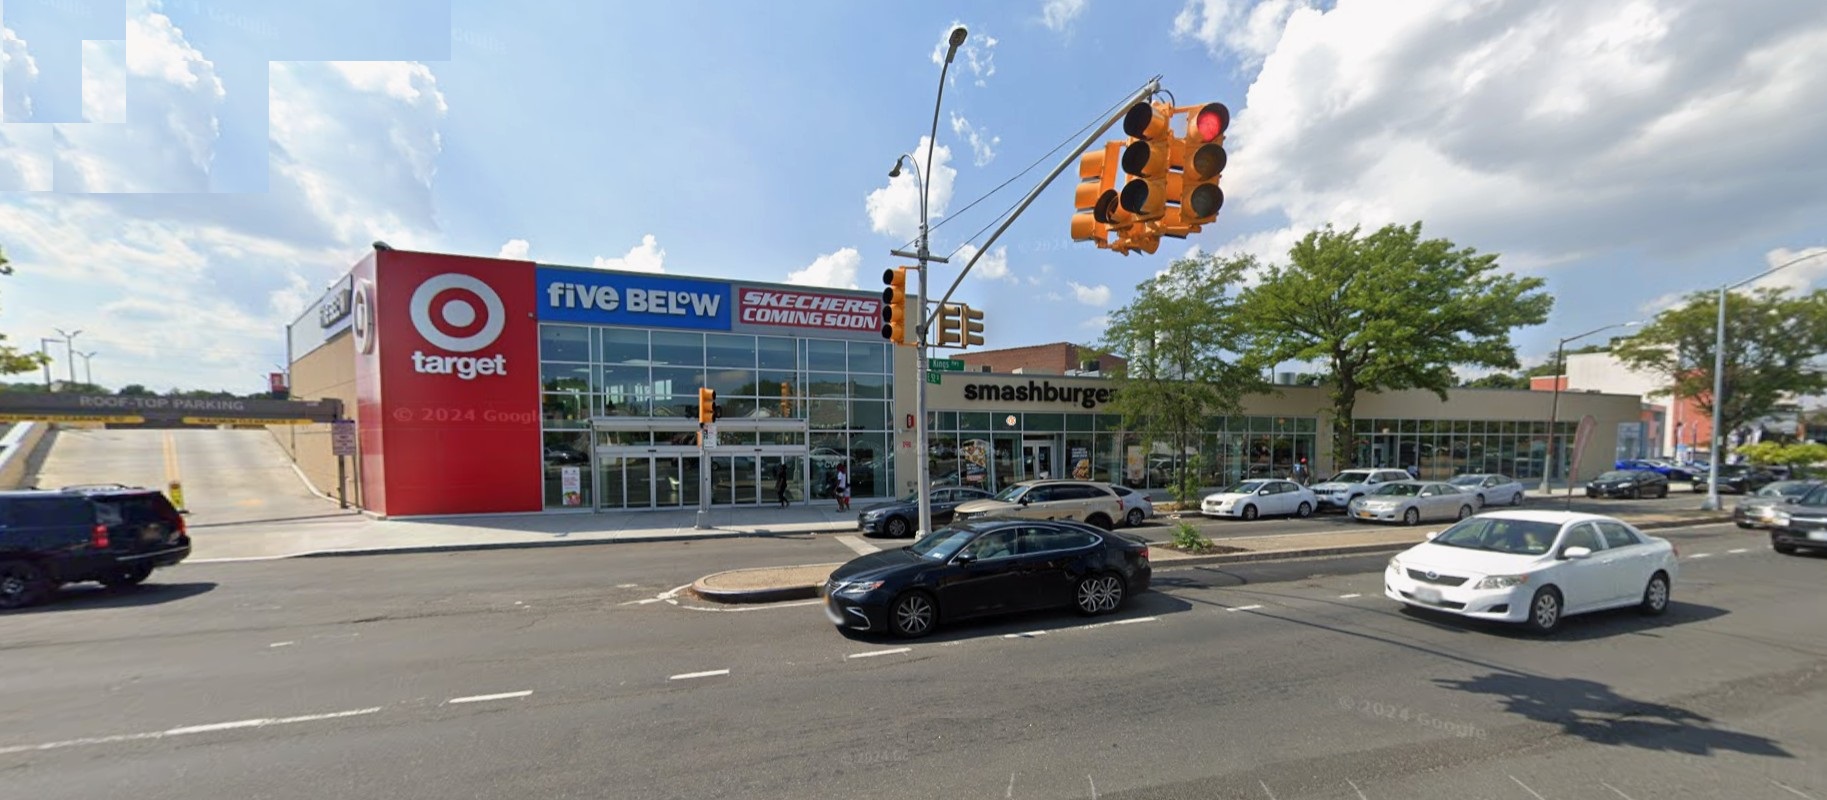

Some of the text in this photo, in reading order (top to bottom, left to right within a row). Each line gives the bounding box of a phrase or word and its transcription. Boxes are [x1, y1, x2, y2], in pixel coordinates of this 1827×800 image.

[547, 282, 720, 317] five BELOW
[742, 291, 879, 314] SKECHERS
[743, 307, 878, 330] COMING SOON
[411, 350, 507, 380] target
[932, 359, 949, 370] Kings
[79, 395, 244, 411] ROOF-TOP PARKING
[964, 380, 1119, 408] smashburger
